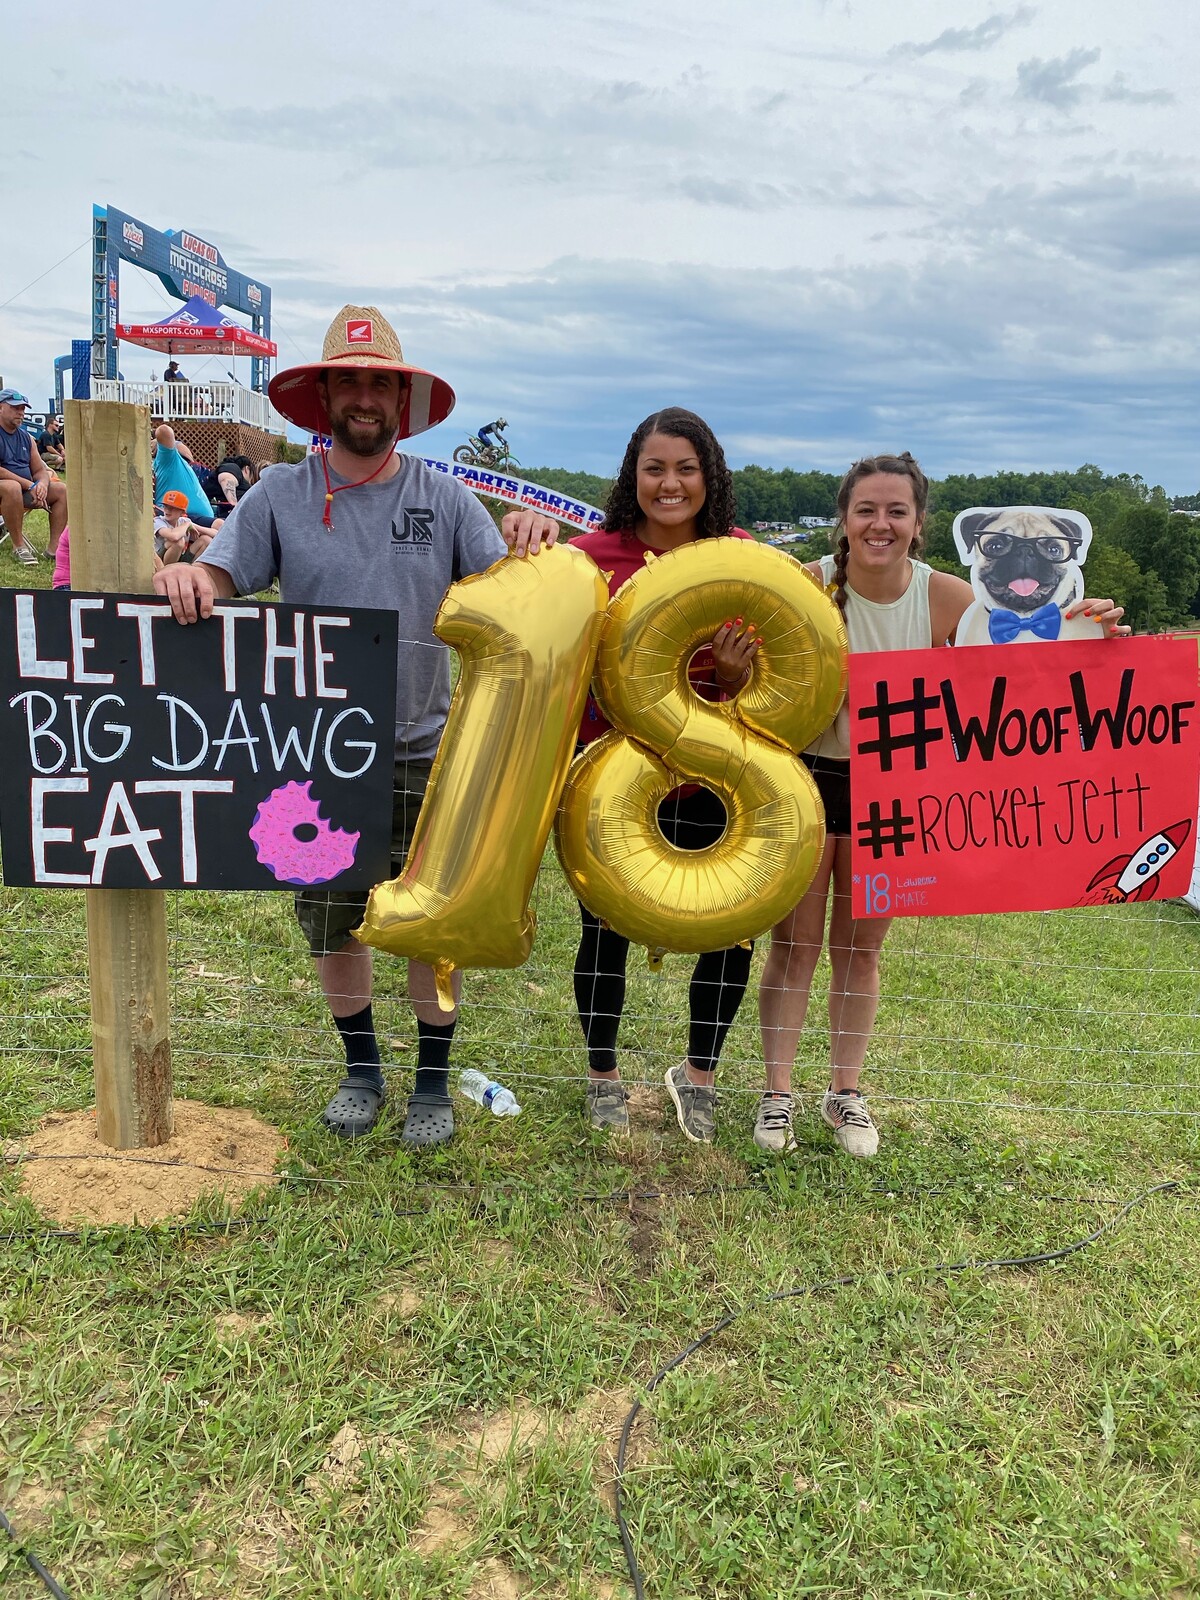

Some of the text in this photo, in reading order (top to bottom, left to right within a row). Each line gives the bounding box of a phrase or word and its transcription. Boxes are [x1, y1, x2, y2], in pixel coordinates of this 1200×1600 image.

[183, 235, 217, 263] LUCAS OIL
[169, 250, 227, 290] MOTOCROSS
[169, 265, 228, 295] CHAMPIONSHIP
[182, 279, 217, 308] FINISH
[142, 326, 203, 336] MXSPORTS.COM
[452, 465, 519, 493] PARTS
[522, 484, 587, 518] PARTS
[458, 478, 517, 500] LIMITED
[520, 495, 584, 525] UNLIMITED
[14, 594, 352, 699] LET THE
[9, 690, 377, 780] BIG DAWG
[31, 776, 235, 885] EAT
[895, 890, 929, 909] MATE
